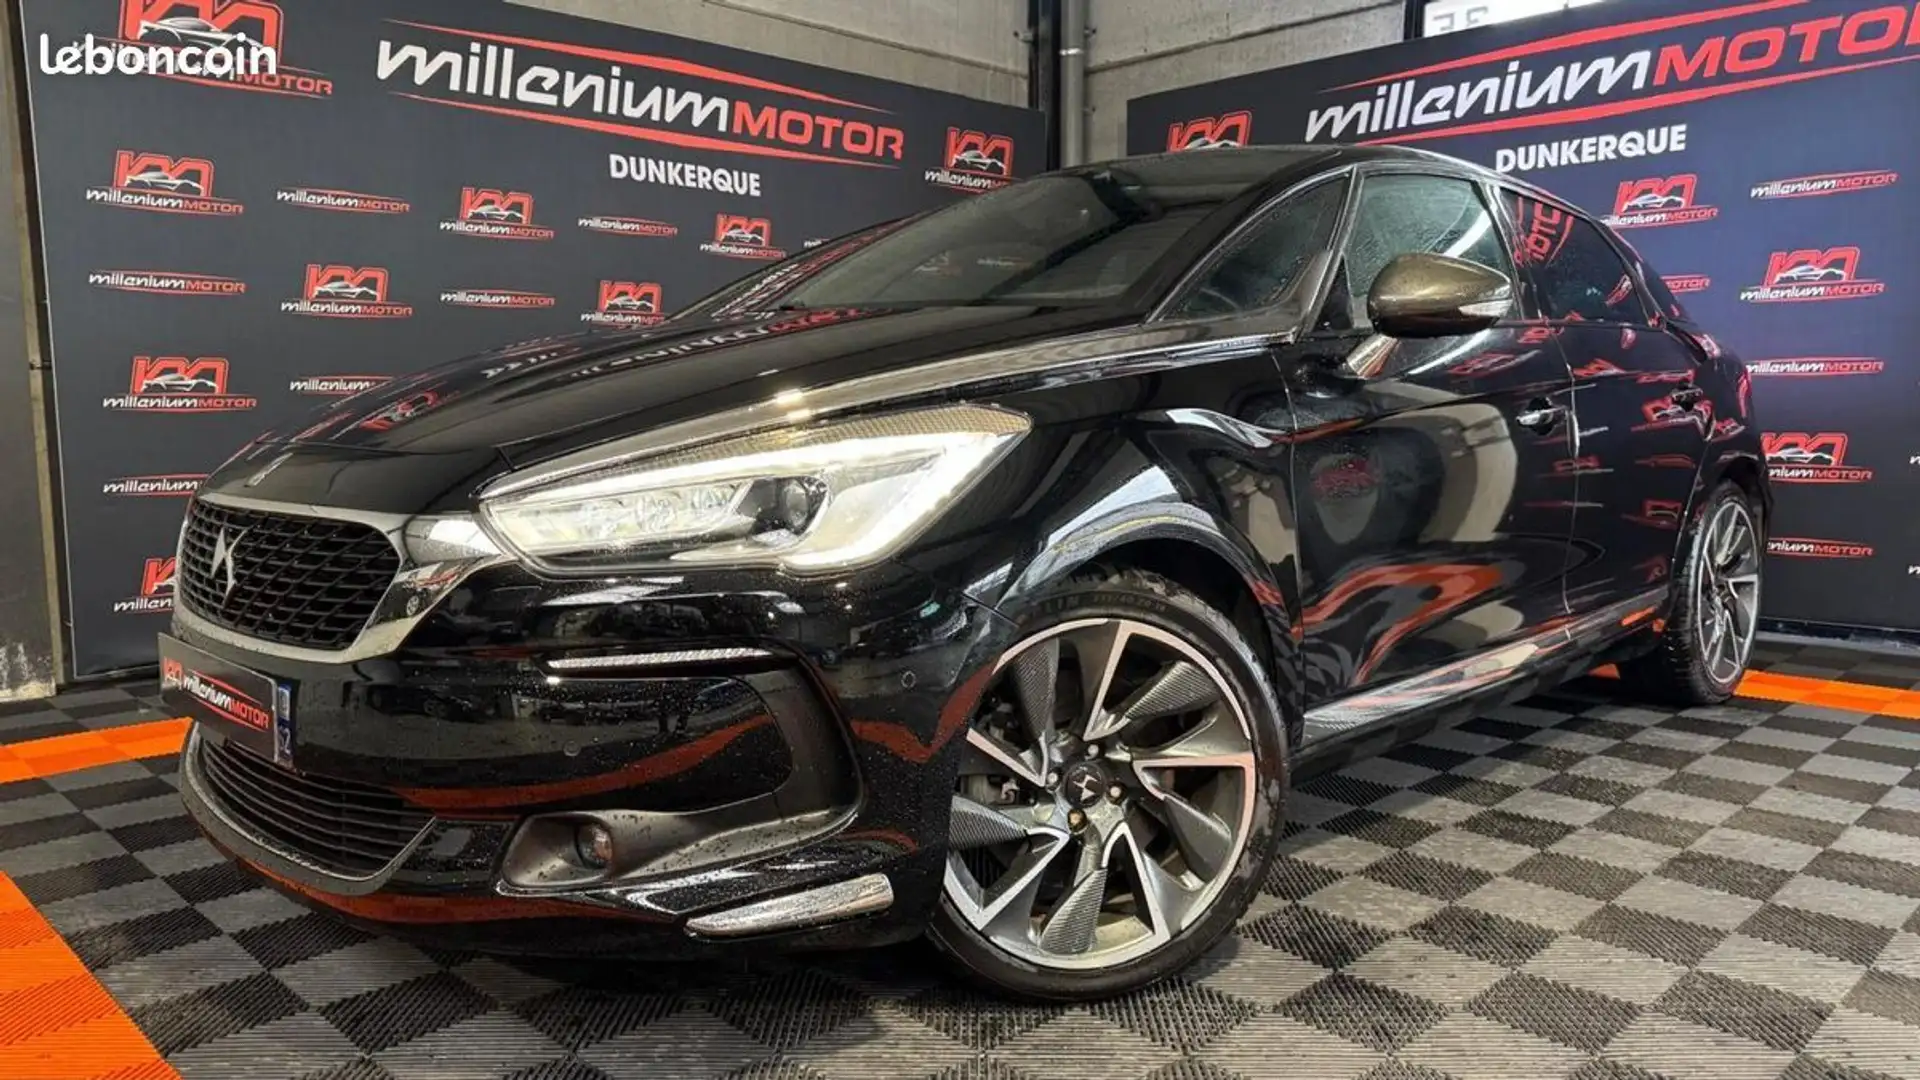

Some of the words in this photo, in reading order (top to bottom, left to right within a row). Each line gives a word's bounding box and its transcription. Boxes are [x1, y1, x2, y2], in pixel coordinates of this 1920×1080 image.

[1496, 124, 1688, 173] DUNKERQUE
[608, 153, 761, 197] DUNKERQUE
[290, 378, 371, 392] millenium
[103, 479, 202, 494] millenium
